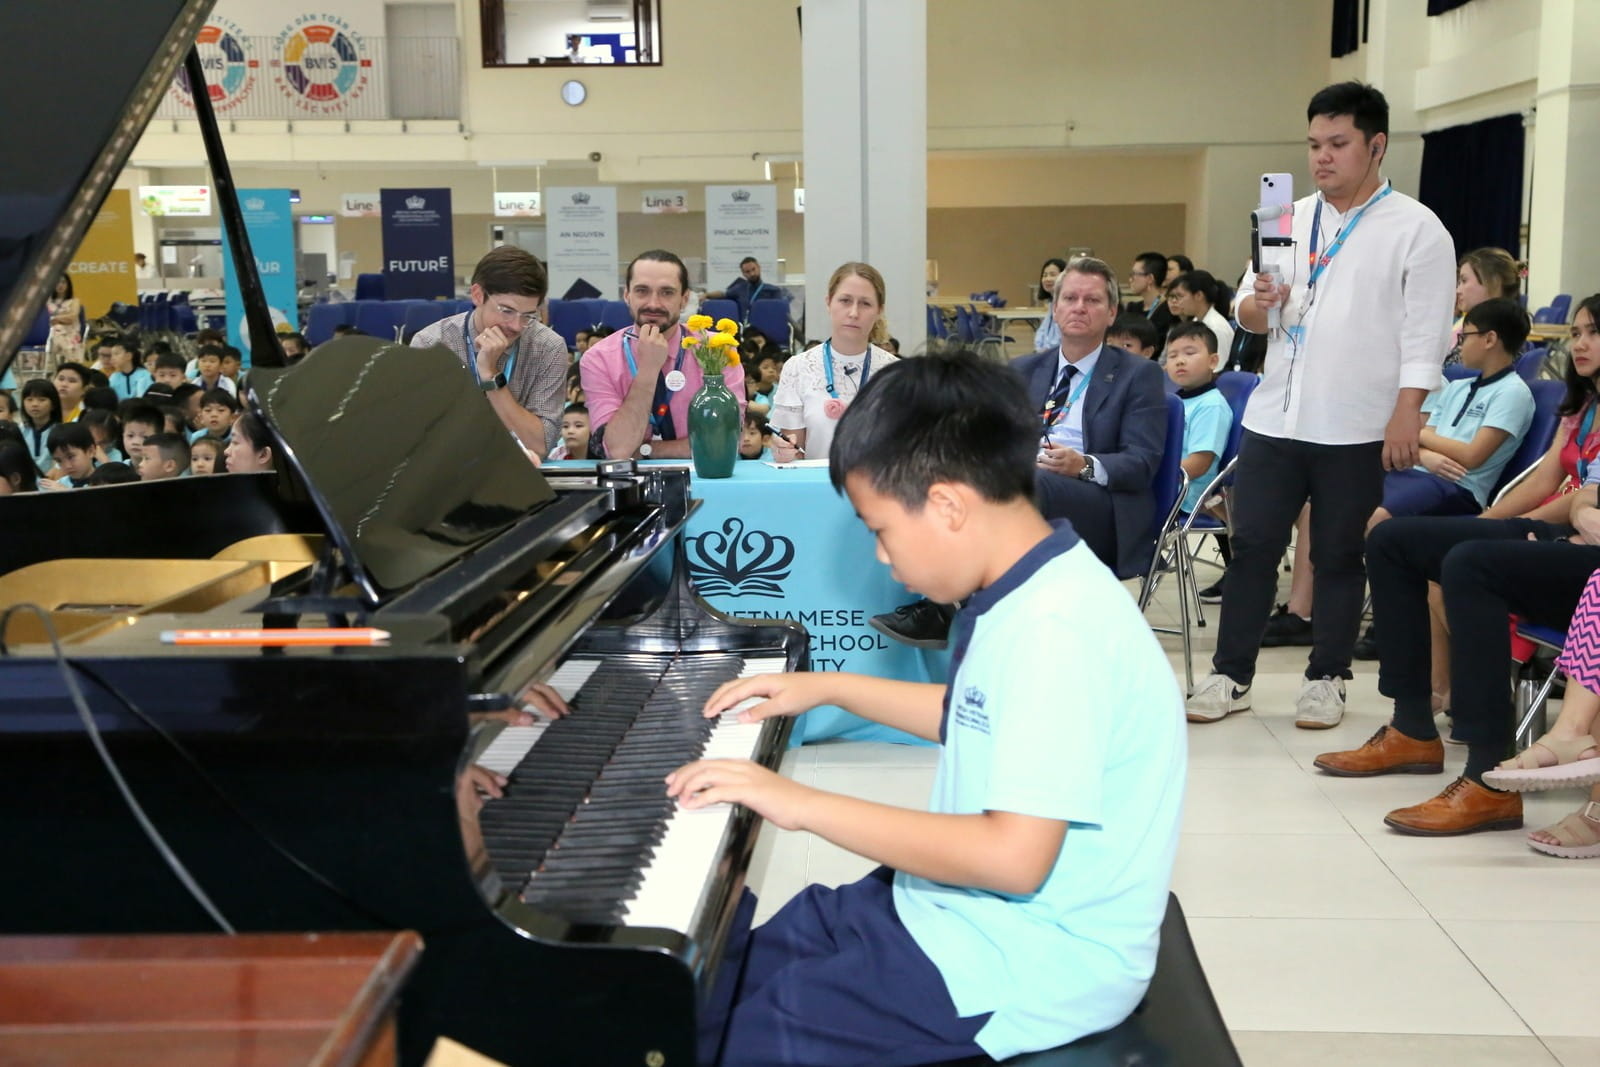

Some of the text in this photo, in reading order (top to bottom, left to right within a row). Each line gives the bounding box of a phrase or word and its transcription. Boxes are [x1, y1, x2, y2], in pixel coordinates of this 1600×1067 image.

[201, 58, 225, 70] VIS
[304, 57, 338, 69] BVIS
[346, 200, 374, 211] Line
[498, 199, 537, 210] Line 2
[645, 196, 684, 207] Line 3
[68, 261, 129, 273] CREATE
[255, 256, 280, 273] UR
[389, 256, 449, 272] FUTURE
[725, 610, 864, 626] ETNAMESE
[809, 634, 889, 651] CHOOL
[811, 658, 846, 672] ITY
